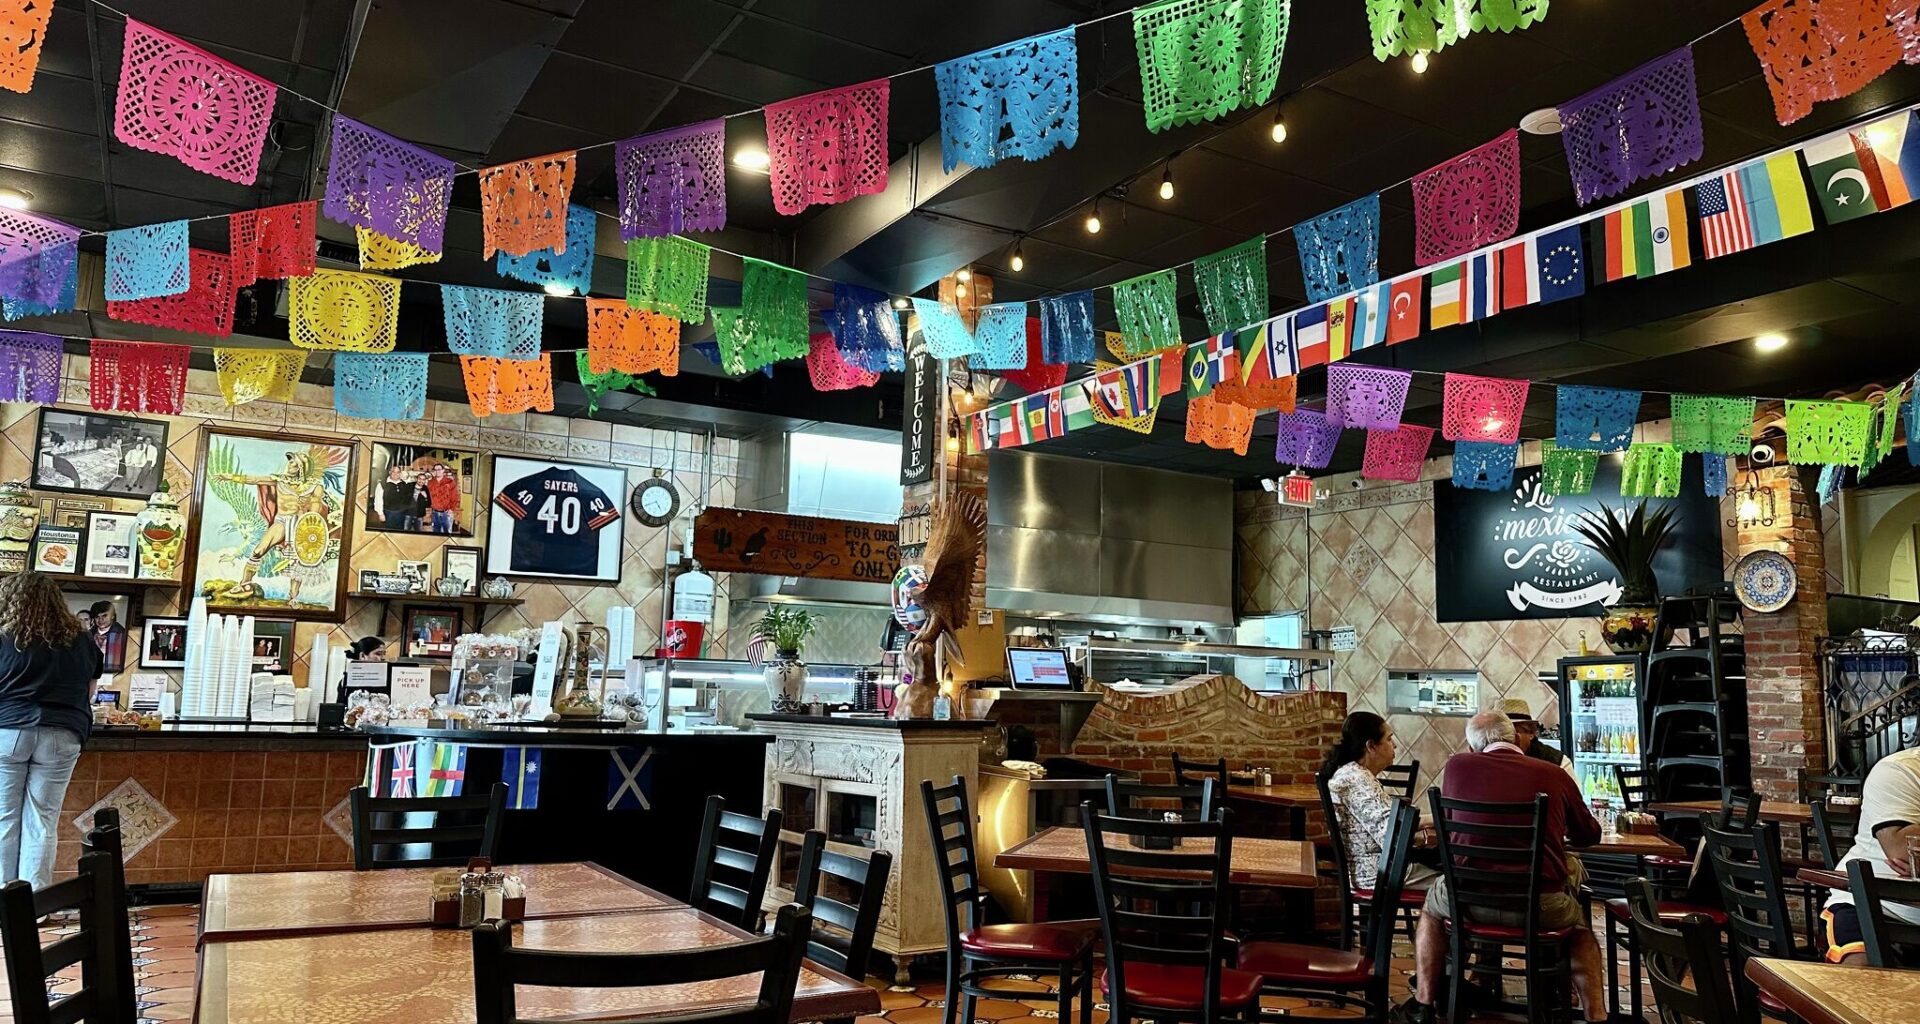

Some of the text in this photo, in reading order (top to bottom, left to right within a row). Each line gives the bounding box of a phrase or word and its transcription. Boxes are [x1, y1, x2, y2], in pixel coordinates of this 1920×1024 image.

[911, 354, 926, 467] WELCOME
[544, 480, 579, 493] SAYERS
[1288, 478, 1313, 503] EXIT
[517, 489, 534, 506] 40
[590, 497, 605, 513] 40
[537, 494, 581, 535] 40
[787, 518, 814, 532] THIS
[900, 519, 930, 545] 1018
[777, 529, 827, 544] SECTION
[844, 526, 899, 542] FOR ORD
[853, 561, 901, 580] ONLY
[1533, 571, 1599, 588] RESTAURANT
[1541, 595, 1564, 604] SINCE
